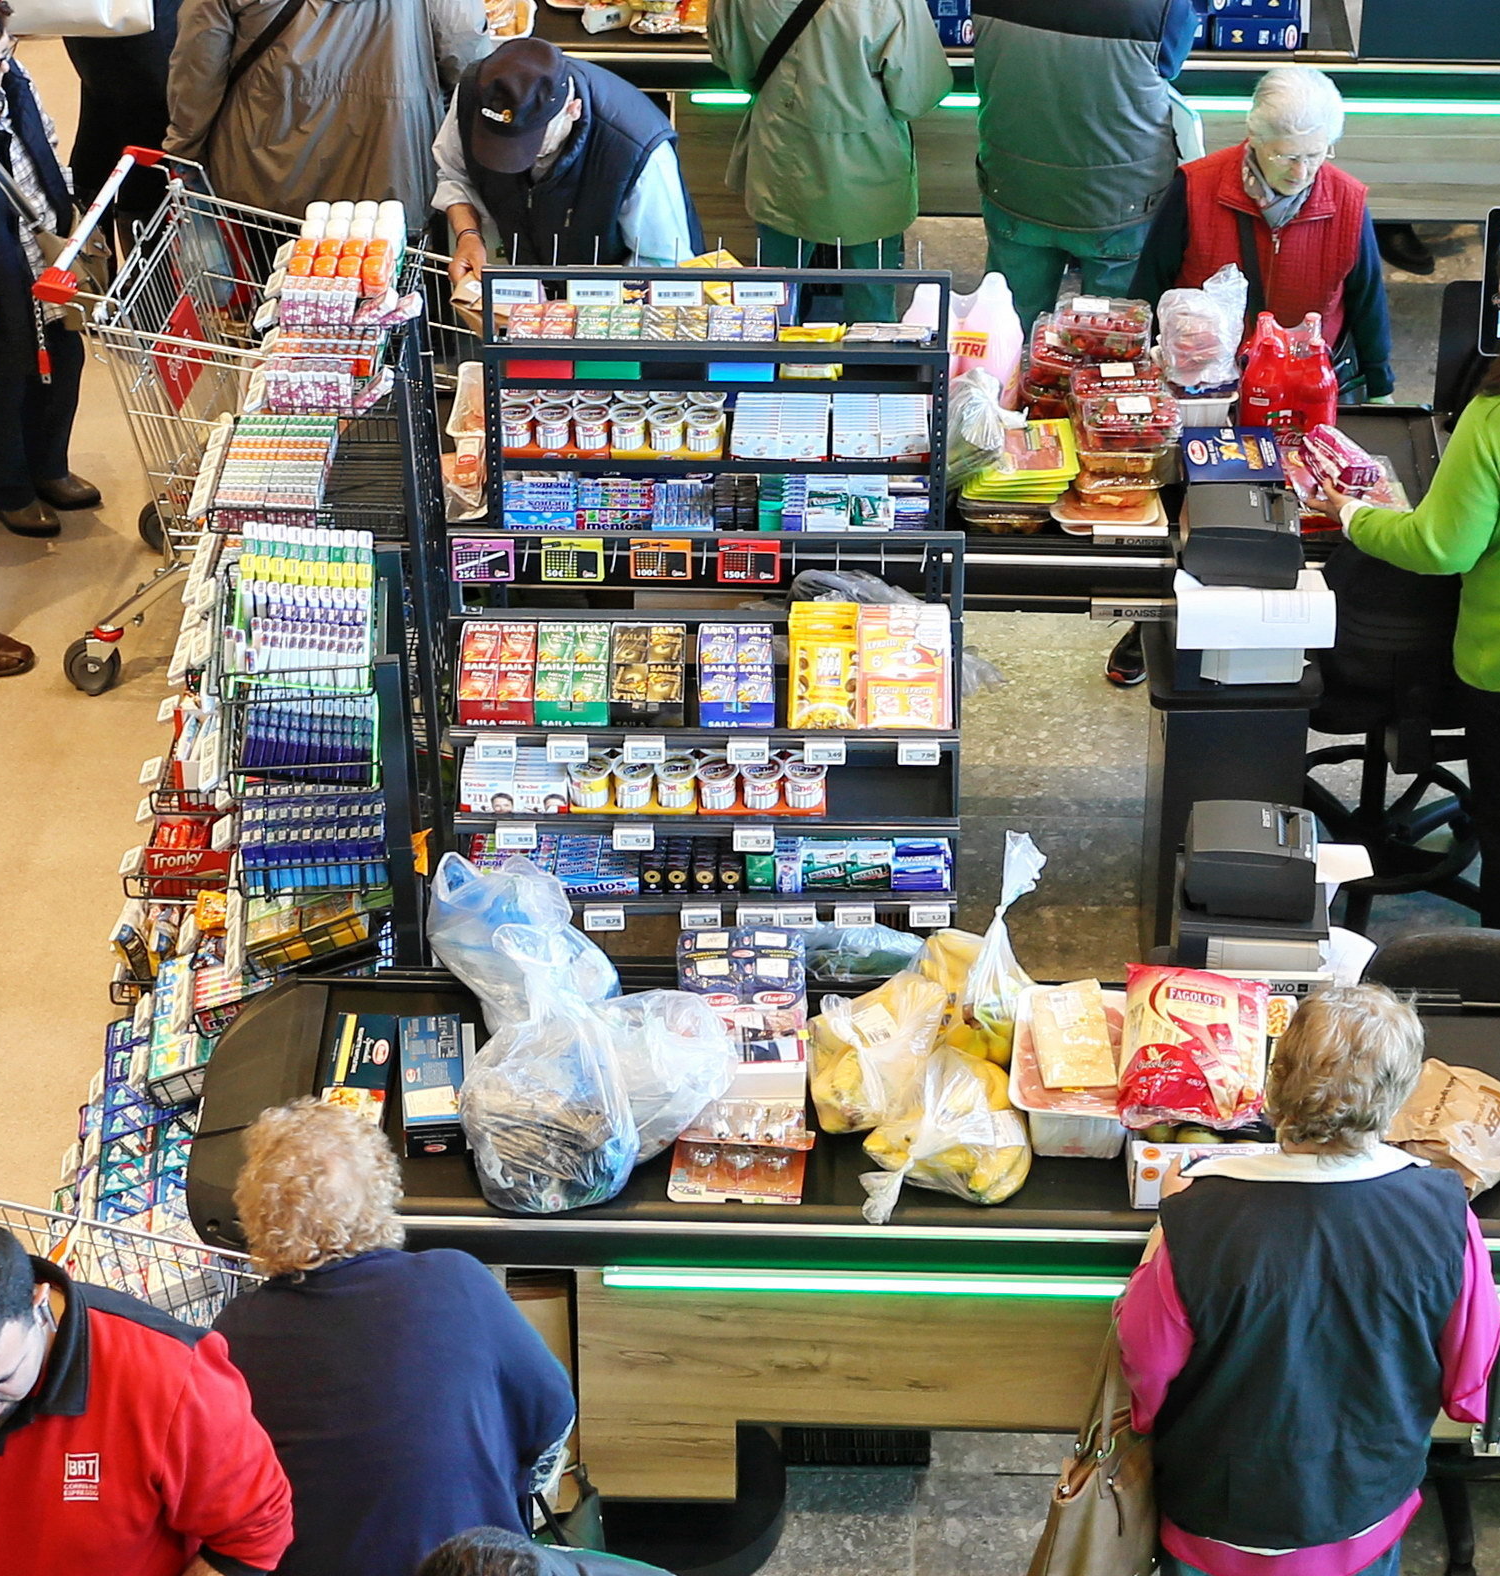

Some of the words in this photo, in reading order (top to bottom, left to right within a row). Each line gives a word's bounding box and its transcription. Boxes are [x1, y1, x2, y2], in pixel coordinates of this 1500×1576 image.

[457, 569, 477, 579] 25€
[546, 569, 564, 578] 50€
[635, 568, 658, 577] 100€
[723, 570, 747, 579] 150€
[150, 852, 203, 871] Tronky
[1167, 986, 1222, 1008] FAGOLOSI
